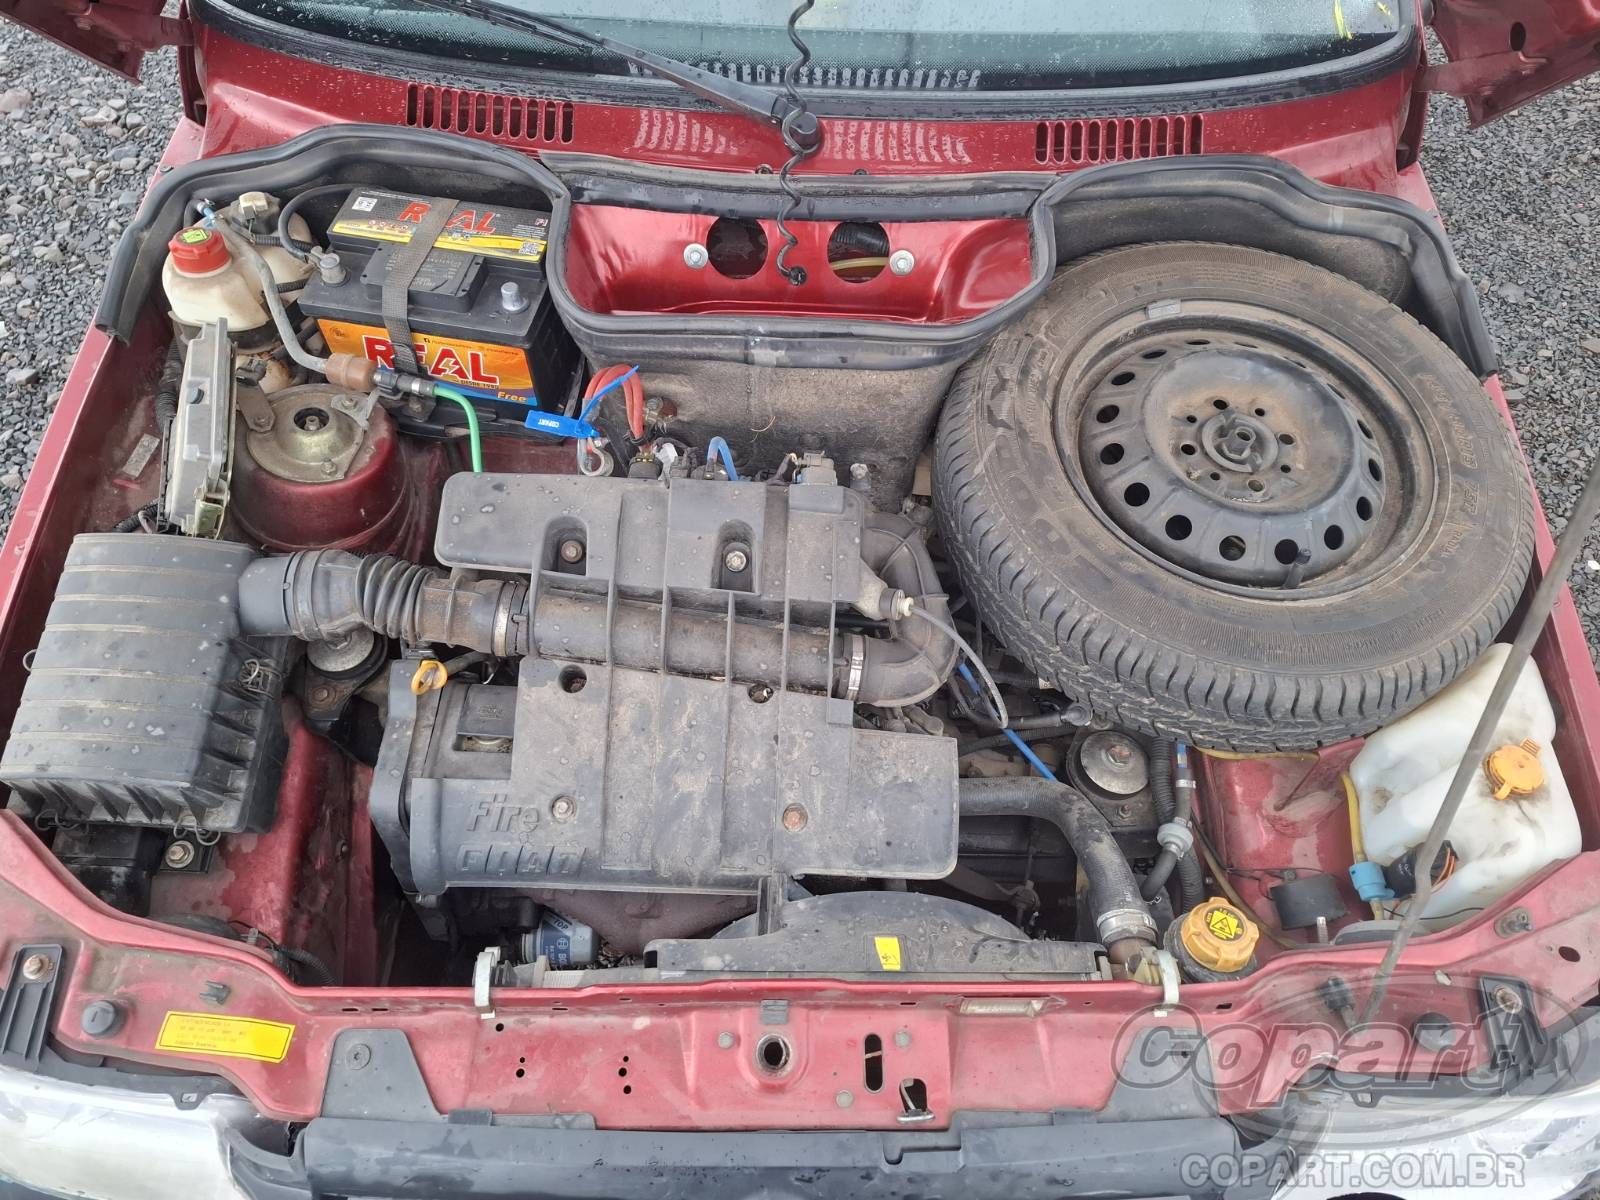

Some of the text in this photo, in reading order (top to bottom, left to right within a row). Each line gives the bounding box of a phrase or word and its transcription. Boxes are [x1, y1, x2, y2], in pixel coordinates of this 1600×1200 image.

[399, 201, 497, 233] RAL
[498, 391, 528, 403] Free
[538, 418, 560, 428] COPART
[460, 845, 578, 876] FIAT
